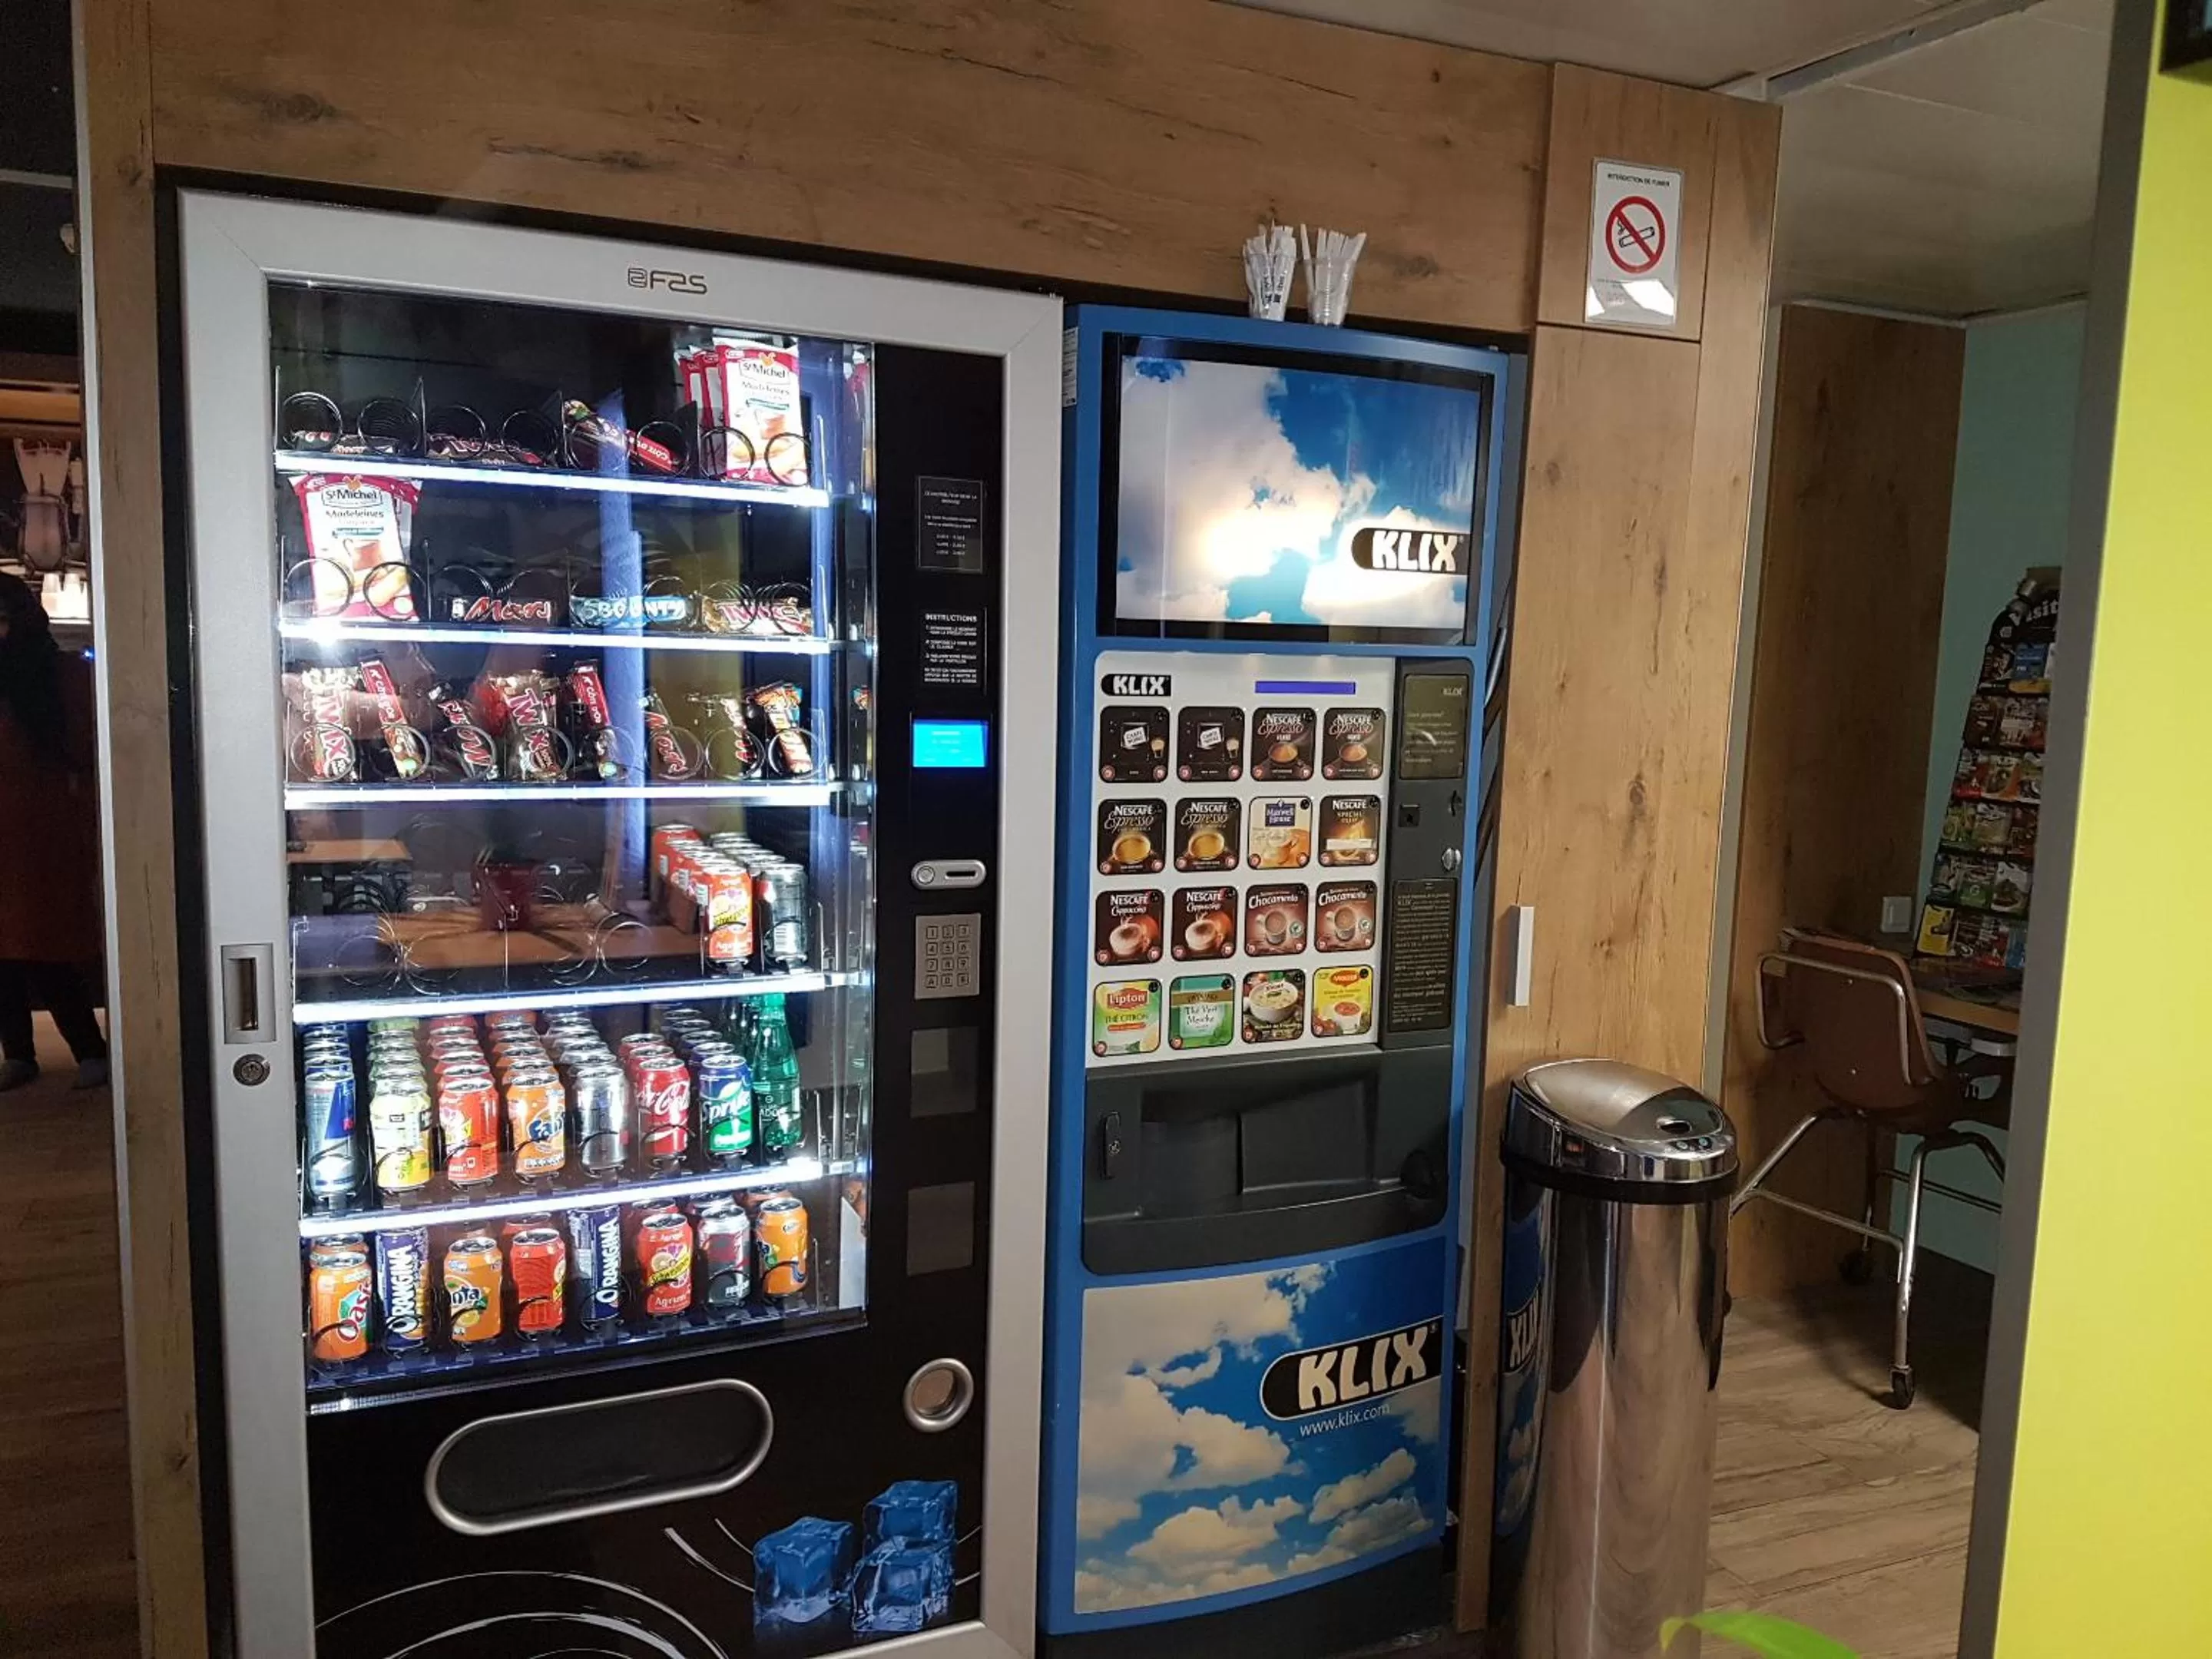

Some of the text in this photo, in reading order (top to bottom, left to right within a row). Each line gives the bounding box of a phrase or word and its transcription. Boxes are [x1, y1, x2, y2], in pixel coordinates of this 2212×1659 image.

[1373, 530, 1458, 571] KLIX
[1114, 675, 1165, 695] KLIX
[1109, 994, 1146, 1005] Lipton
[595, 1216, 620, 1304] ORANGINA
[386, 1244, 419, 1333] ORANGINA
[1298, 1326, 1428, 1410] KLIX
[1300, 1404, 1390, 1438] www.klix.com
